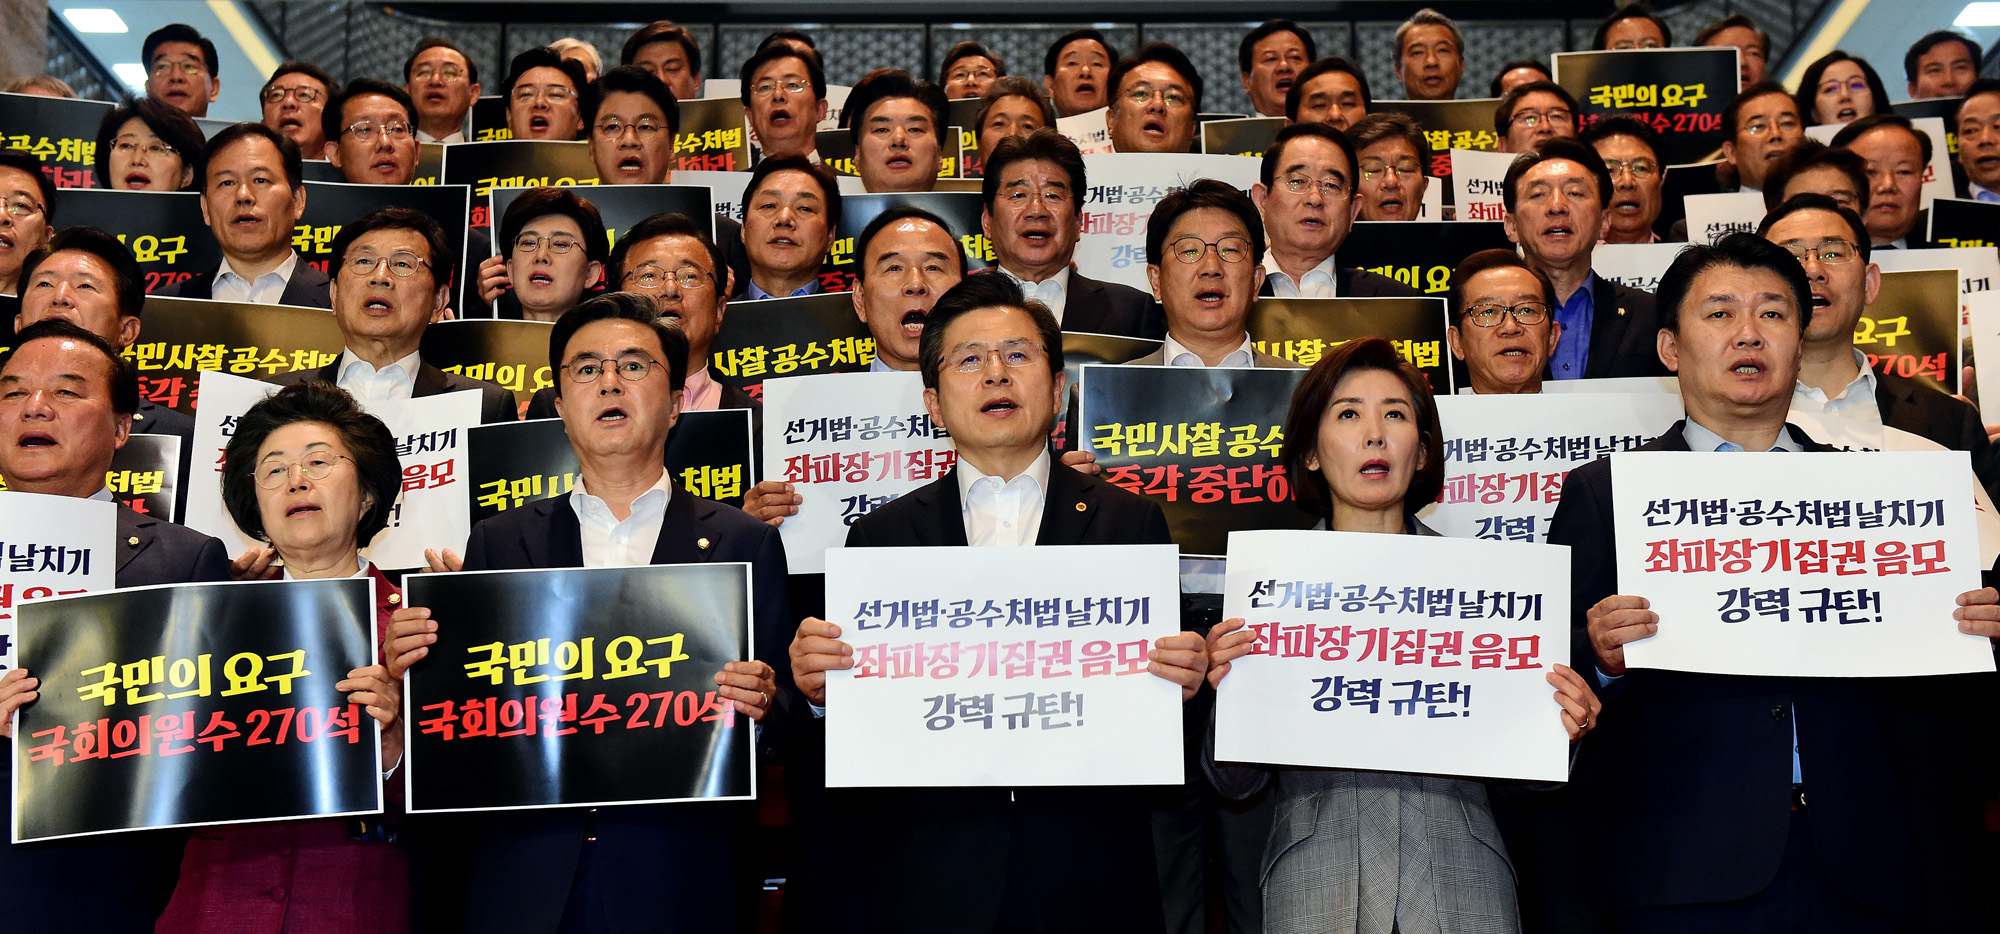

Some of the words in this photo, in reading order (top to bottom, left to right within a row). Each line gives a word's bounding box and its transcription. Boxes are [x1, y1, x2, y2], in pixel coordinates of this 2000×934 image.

[1589, 83, 1657, 108] 국민의
[1661, 83, 1708, 108] 요구
[1453, 130, 1499, 150] 공수
[132, 234, 189, 265] 요구
[1091, 421, 1226, 458] 국민사찰
[402, 458, 456, 493] 음모
[1435, 471, 1569, 505] 파장기집
[1642, 499, 1851, 529] 선거법·공수처법
[1855, 498, 1945, 529] 날치기
[8, 542, 91, 576] 날치기
[1645, 538, 1867, 575] 좌파장기집권
[1872, 539, 1952, 577] 음모
[853, 597, 1061, 631] 선거법·공수처법
[1066, 596, 1151, 629] 날치기
[1247, 578, 1455, 618] 선거법·공수처법
[1458, 589, 1543, 622] 날치기
[1717, 587, 1790, 623] 강력
[1798, 587, 1883, 625] 규탄!
[463, 637, 595, 686] 국민의
[601, 632, 690, 681] 요구
[853, 639, 1074, 680] 좌파장기집권
[1078, 638, 1150, 677] 음모
[1248, 621, 1464, 668] 좌파장기집권
[1468, 632, 1544, 671] 음모
[76, 654, 212, 706] 국민의
[220, 649, 312, 697] 요구
[418, 691, 622, 741] 국회의원수
[625, 690, 735, 730] 270석
[922, 692, 995, 731] 강력
[1000, 690, 1085, 731] 규탄!
[1310, 675, 1383, 714] 강력
[1388, 679, 1473, 719] 규탄!
[27, 709, 242, 767] 국회의원수
[245, 703, 361, 748] 270석
